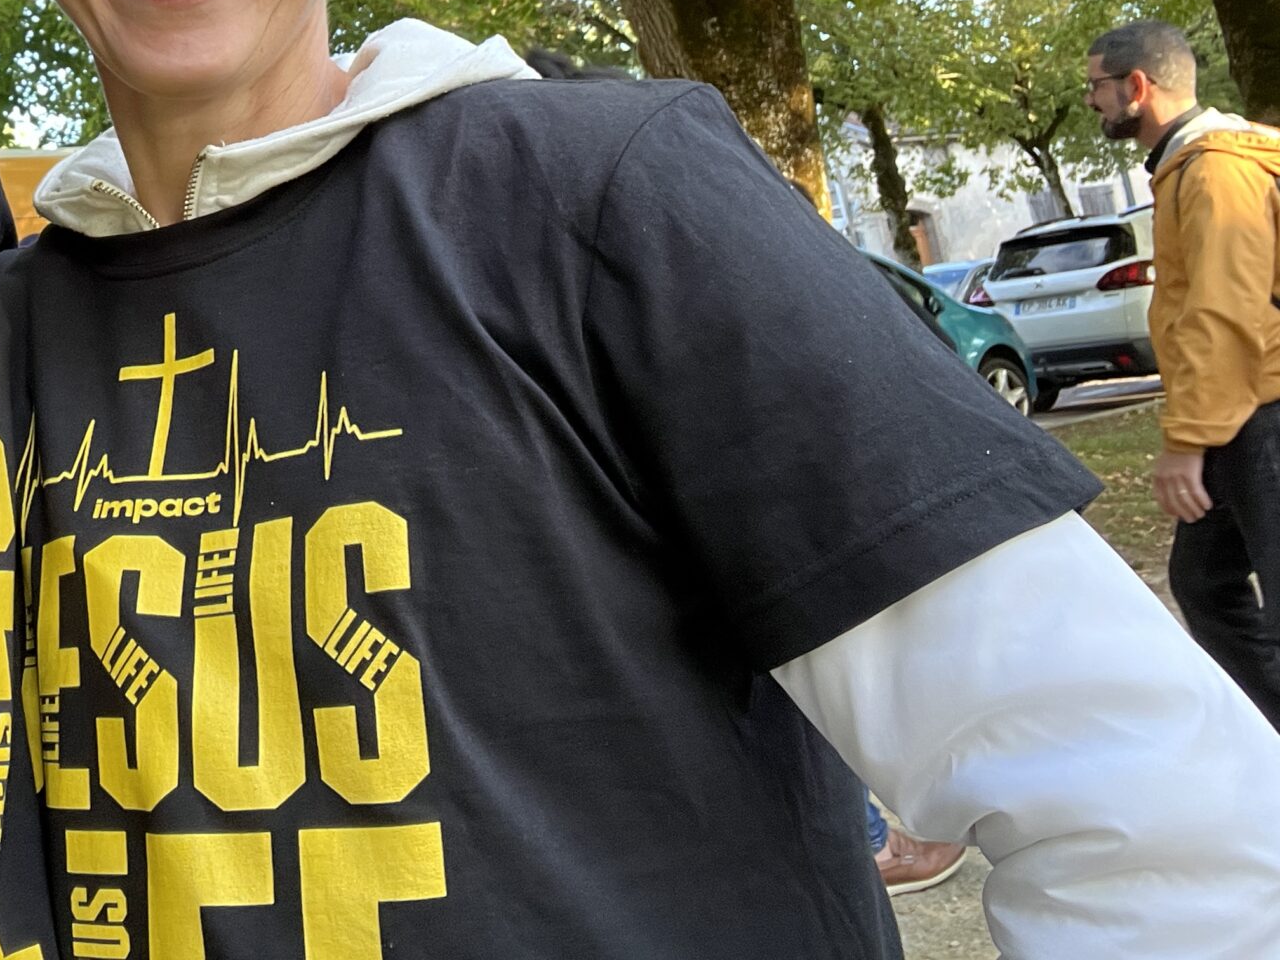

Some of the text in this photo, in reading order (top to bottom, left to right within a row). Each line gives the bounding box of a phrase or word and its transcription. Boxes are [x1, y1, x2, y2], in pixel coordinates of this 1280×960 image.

[92, 491, 222, 523] impact
[194, 548, 237, 617] LIFE
[102, 626, 160, 705] LIFE
[324, 609, 398, 691] LIFE
[40, 695, 61, 764] LIFE
